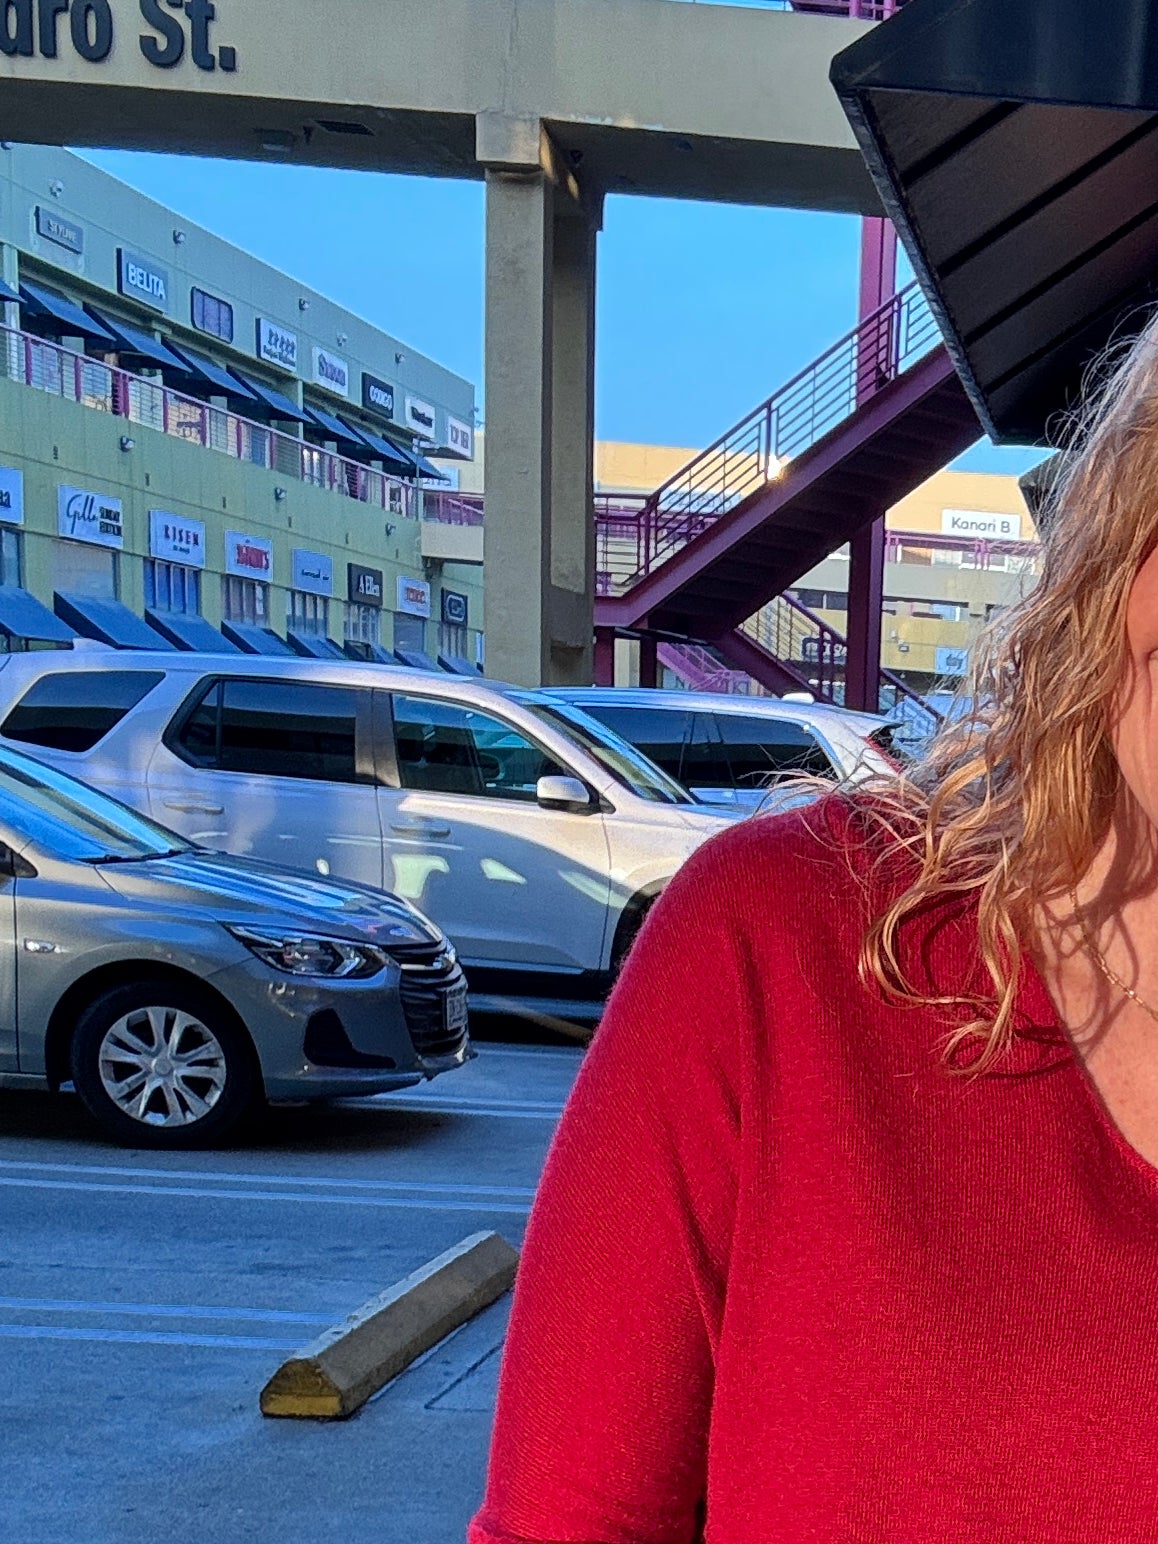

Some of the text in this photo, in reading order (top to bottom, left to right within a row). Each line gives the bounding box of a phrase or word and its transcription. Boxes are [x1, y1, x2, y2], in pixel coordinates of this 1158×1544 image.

[139, 0, 236, 72] St.
[127, 262, 166, 300] BELITA
[951, 517, 1011, 534] Kanari B
